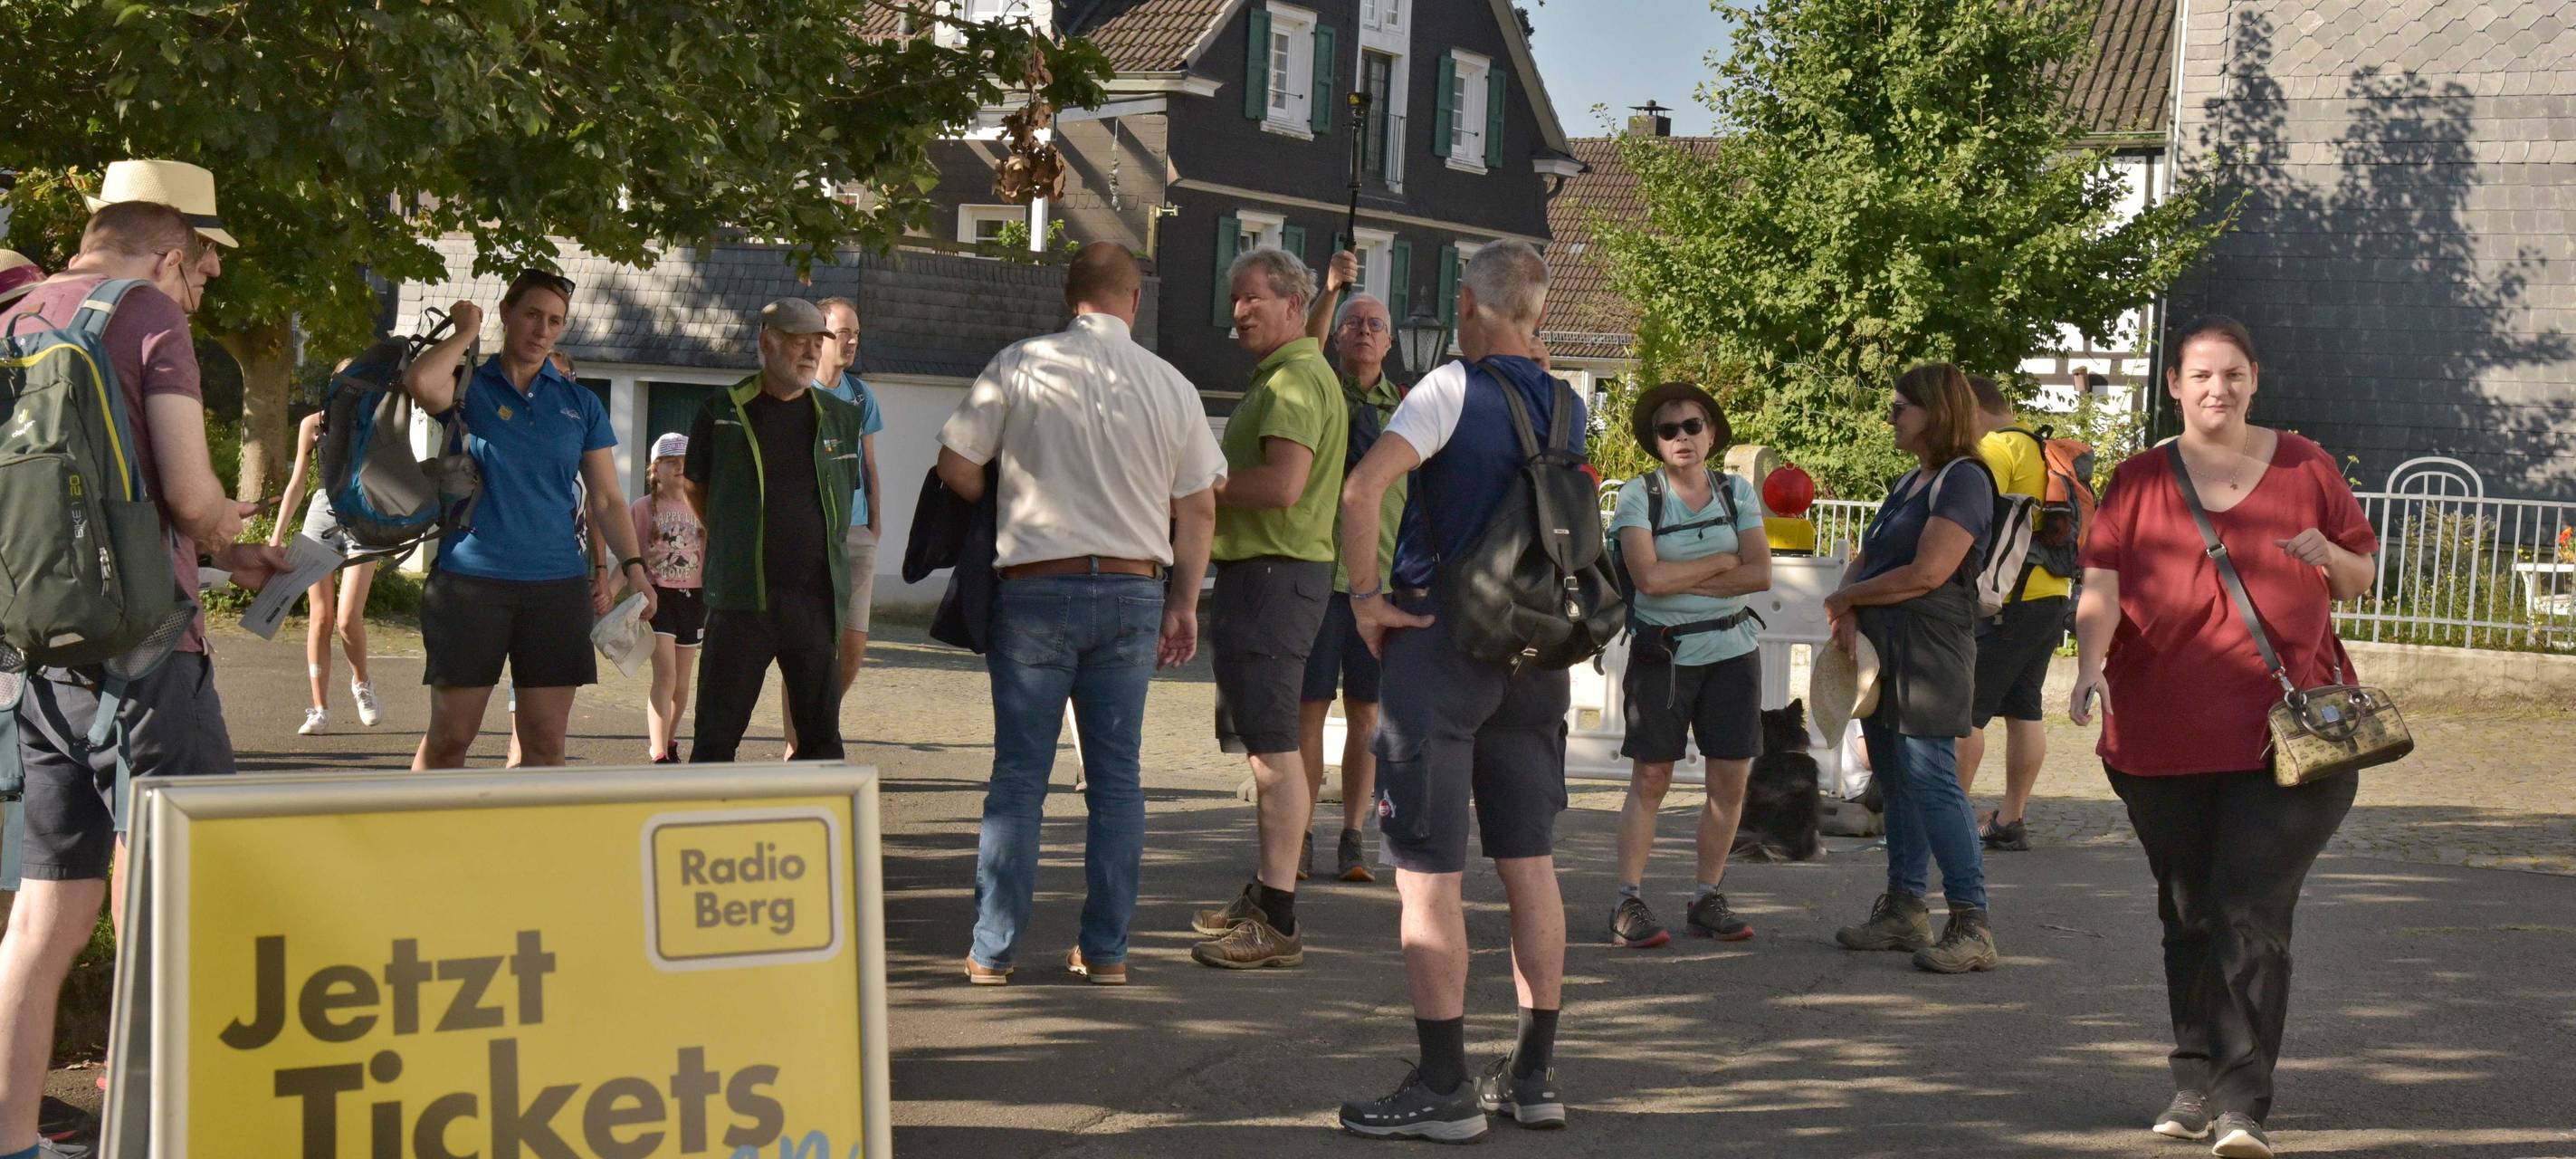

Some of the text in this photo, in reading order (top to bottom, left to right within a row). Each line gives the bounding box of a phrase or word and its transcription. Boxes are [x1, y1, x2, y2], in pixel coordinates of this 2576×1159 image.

[69, 474, 82, 496] 20
[72, 510, 88, 539] BIKE
[656, 511, 682, 526] APPY
[661, 567, 691, 580] LOVE
[681, 841, 806, 886] Radio
[695, 891, 796, 936] Berg
[218, 929, 556, 1050] Jetzt
[273, 1038, 784, 1159] Tickets
